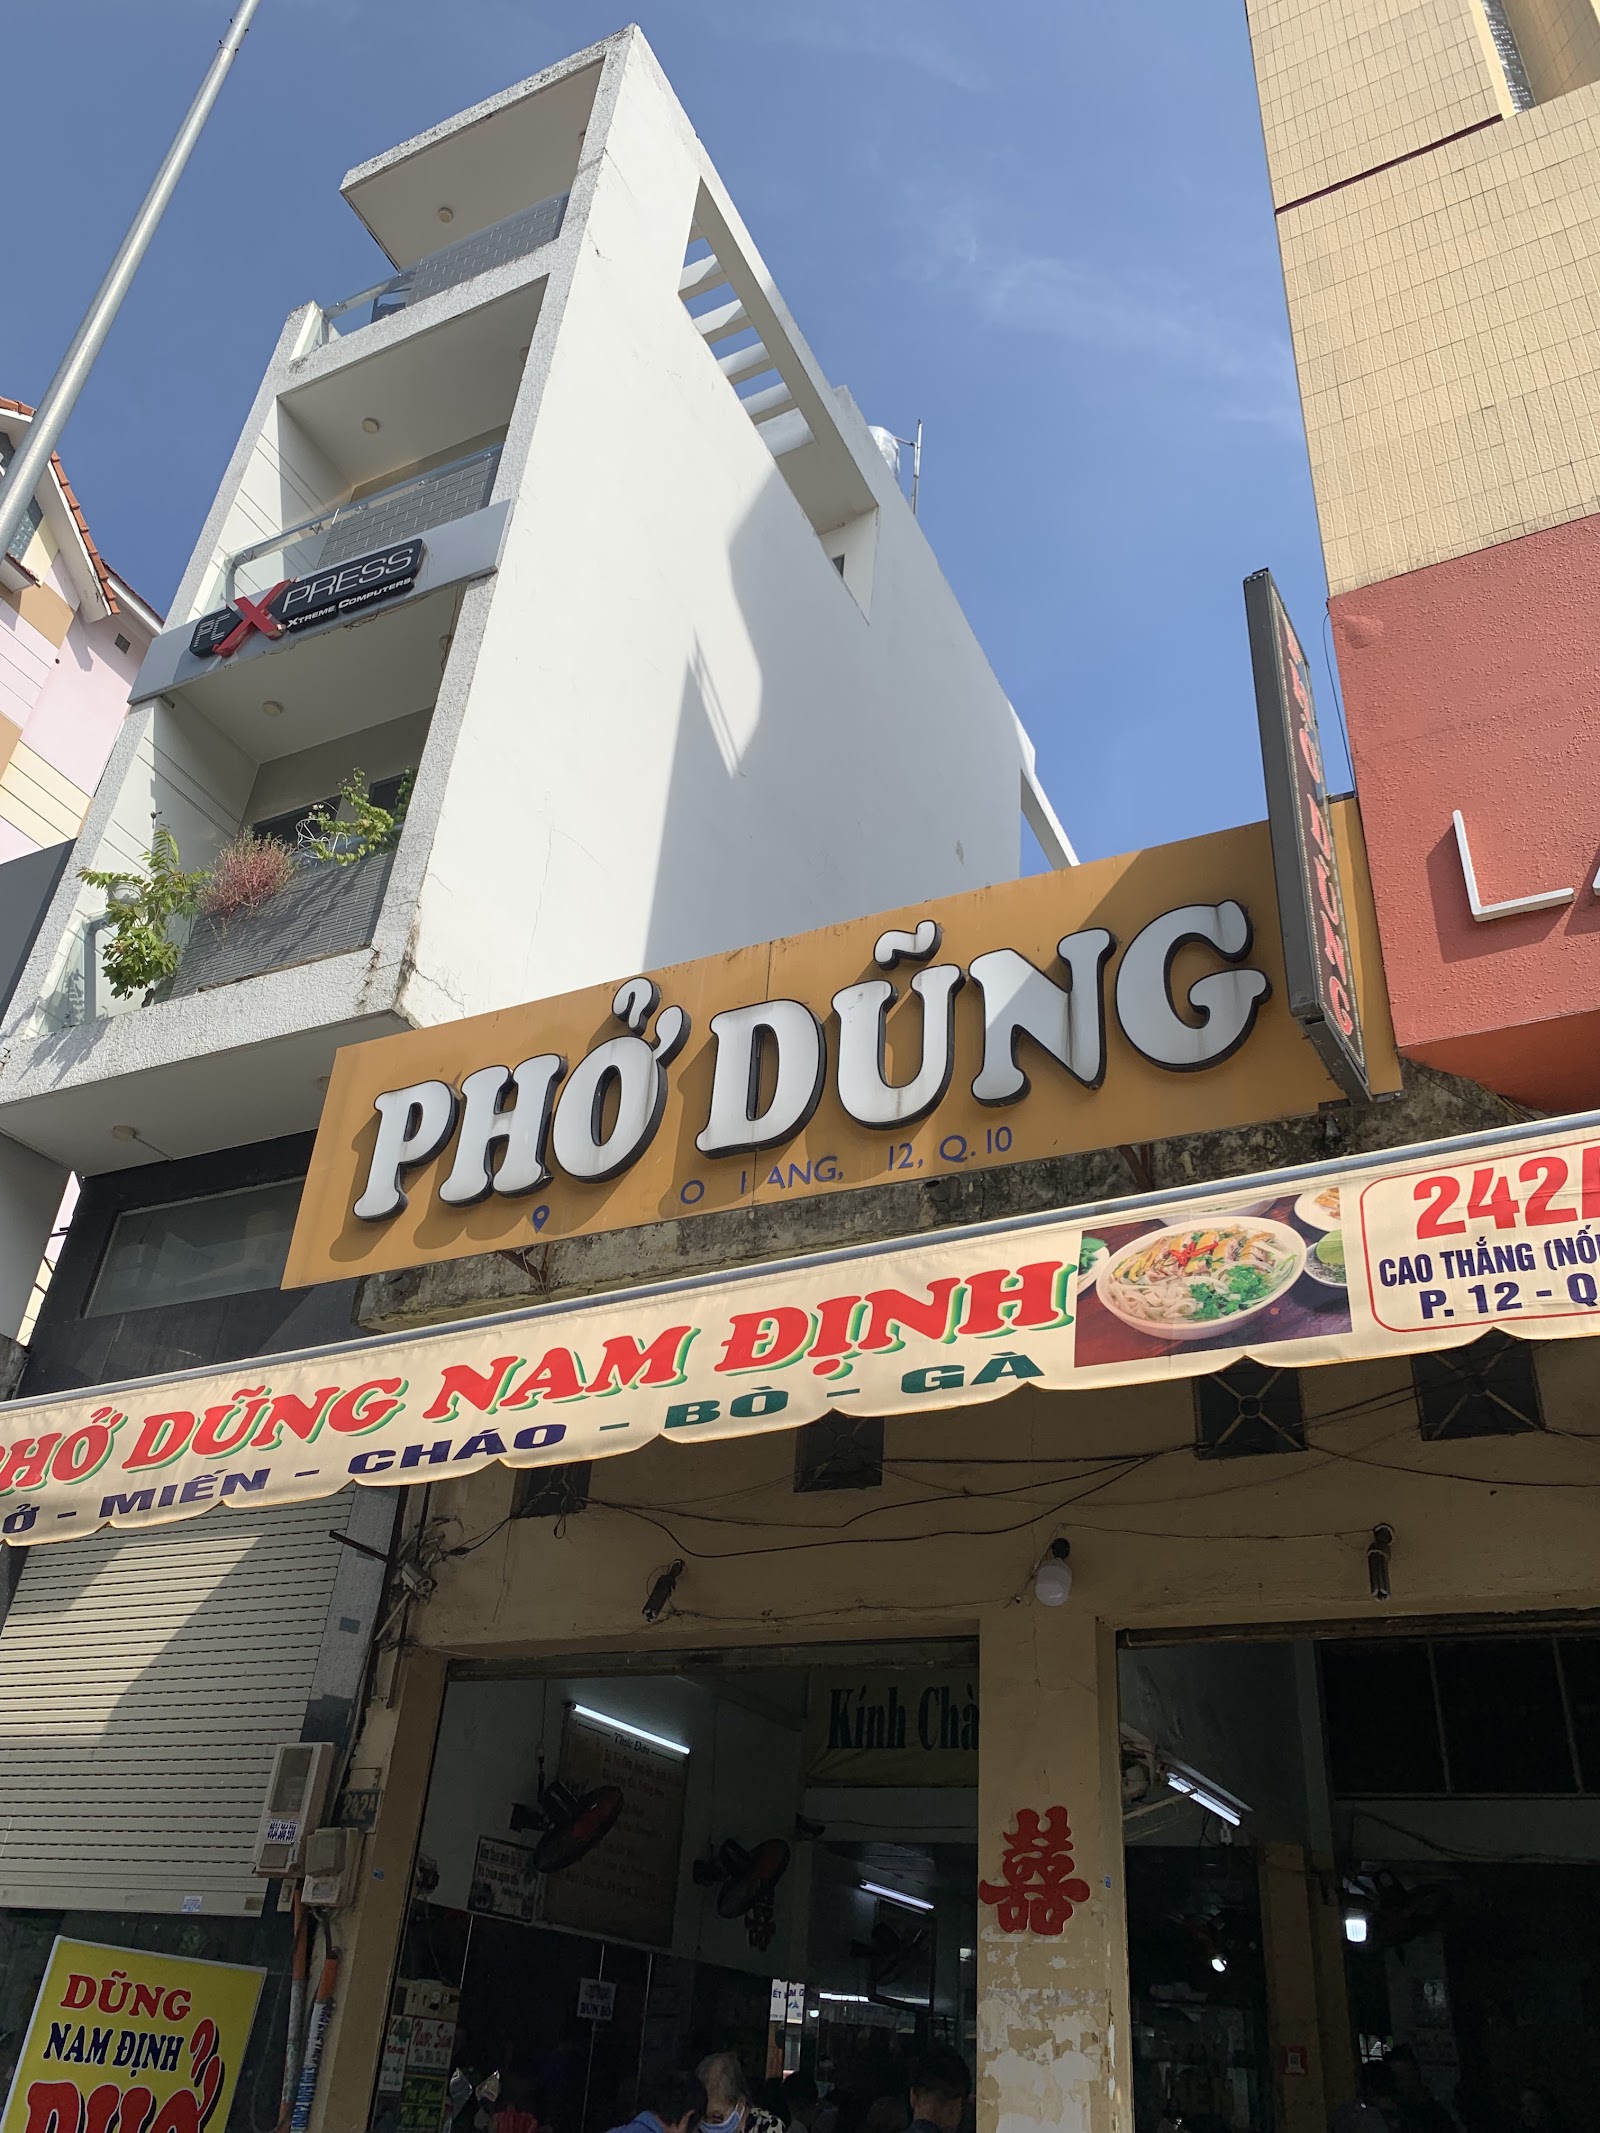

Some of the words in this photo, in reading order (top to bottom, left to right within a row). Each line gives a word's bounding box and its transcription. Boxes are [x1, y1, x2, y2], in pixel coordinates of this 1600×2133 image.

[353, 977, 691, 1222] PHỞ
[695, 900, 1272, 1159] DŨNG
[888, 1143, 923, 1173] 12,
[1379, 1254, 1433, 1287] CAO
[1440, 1236, 1536, 1280] THẮNG
[1419, 1289, 1454, 1319] P.
[1468, 1282, 1522, 1313] 12
[0, 1406, 127, 1496] HỞ
[121, 1377, 409, 1473] DŨNG
[423, 1325, 701, 1423] NAM
[714, 1261, 1078, 1380] ĐỊNH
[99, 1468, 271, 1518] MIẾN
[348, 1424, 566, 1474] CHÁO
[664, 1385, 788, 1429] BÒ
[900, 1351, 1045, 1394] GÀ
[827, 1684, 906, 1749] Kính
[60, 1970, 192, 2021] DŨNG
[43, 2022, 113, 2065] NAM
[112, 2030, 184, 2077] ĐỊNH
